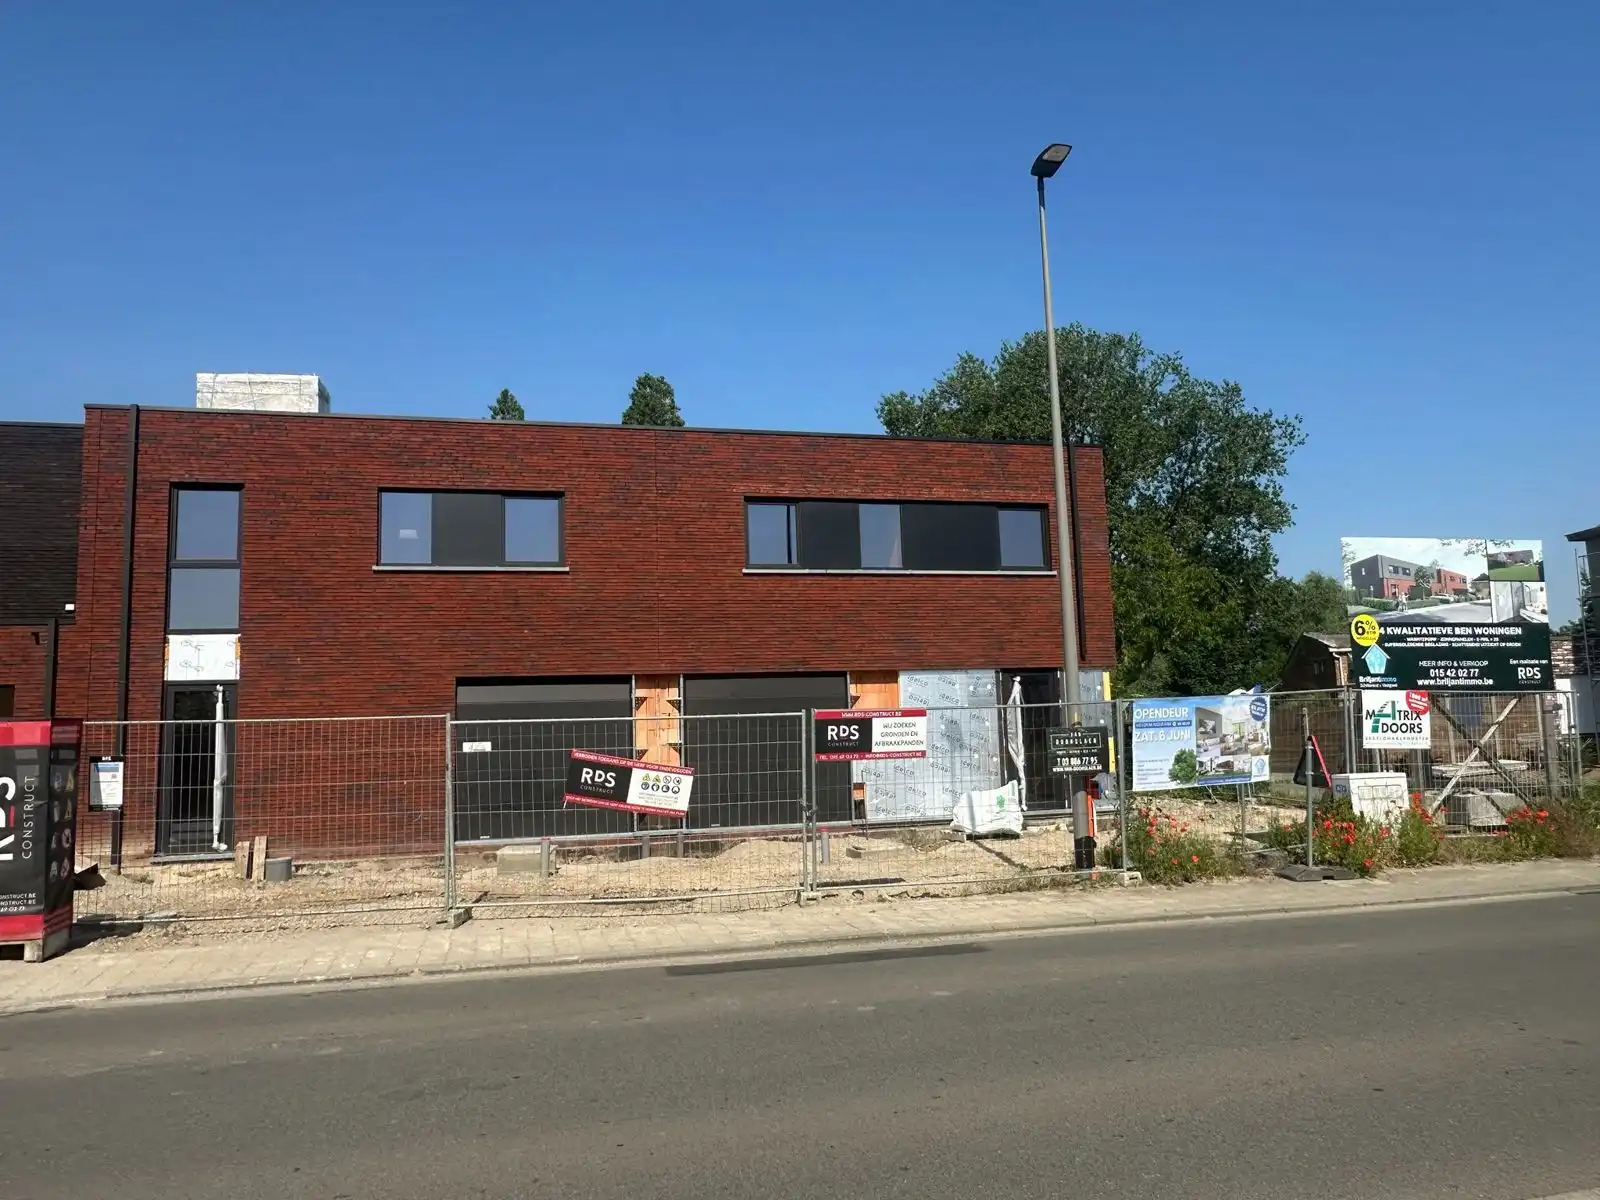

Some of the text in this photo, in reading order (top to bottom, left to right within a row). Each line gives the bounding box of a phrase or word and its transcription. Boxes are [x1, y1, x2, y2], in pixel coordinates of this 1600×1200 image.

[1386, 626, 1454, 635] KWALITATIEVE
[1455, 626, 1472, 635] BEN
[1474, 626, 1522, 635] WONINGEN
[1429, 669, 1479, 677] 015 42 02 77
[1517, 667, 1541, 680] RDS
[1416, 678, 1494, 687] www.briljantimmo.be
[1134, 707, 1189, 719] OPENDEUR
[827, 725, 859, 740] RDS
[1381, 723, 1423, 734] DOORS
[1167, 729, 1191, 740] JUNI
[1082, 756, 1089, 765] 77
[580, 767, 617, 788] RDS
[580, 784, 614, 795] CONSTRUCT
[21, 776, 36, 860] CONSTRUCT
